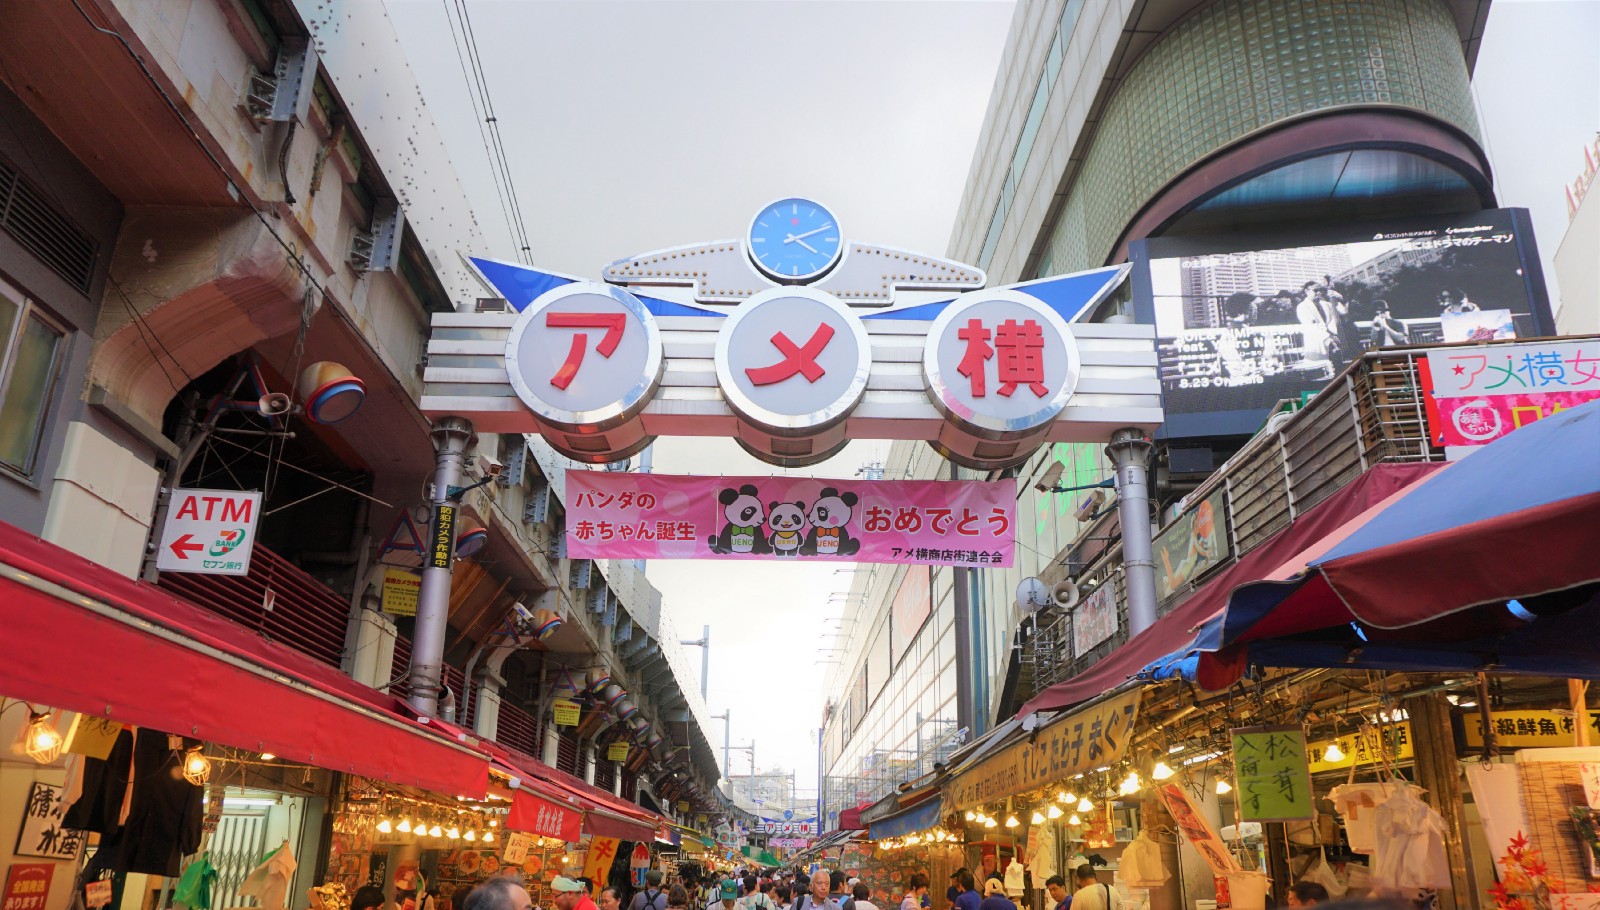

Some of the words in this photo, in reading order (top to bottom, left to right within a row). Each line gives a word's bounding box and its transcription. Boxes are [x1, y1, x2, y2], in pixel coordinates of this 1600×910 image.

[1176, 341, 1208, 353] feat.
[1254, 336, 1289, 349] Nda
[546, 311, 1050, 397] アメ横
[1179, 377, 1210, 388] 8.23
[1459, 411, 1482, 425] あま
[1467, 421, 1496, 435] ちゃん
[175, 495, 253, 523] ATM
[575, 490, 656, 510] パンダの
[863, 505, 1011, 538] おめでとう
[434, 506, 453, 567] 防犯カメラ作動中
[575, 520, 697, 542] 赤ちゃん誕生
[731, 538, 754, 547] UENO
[816, 539, 839, 548] UENO
[891, 547, 1004, 564] アメ横商店街連合会
[203, 560, 243, 571] セブン銀行
[1237, 734, 1262, 815] 入荷です
[1264, 733, 1299, 804] 松茸
